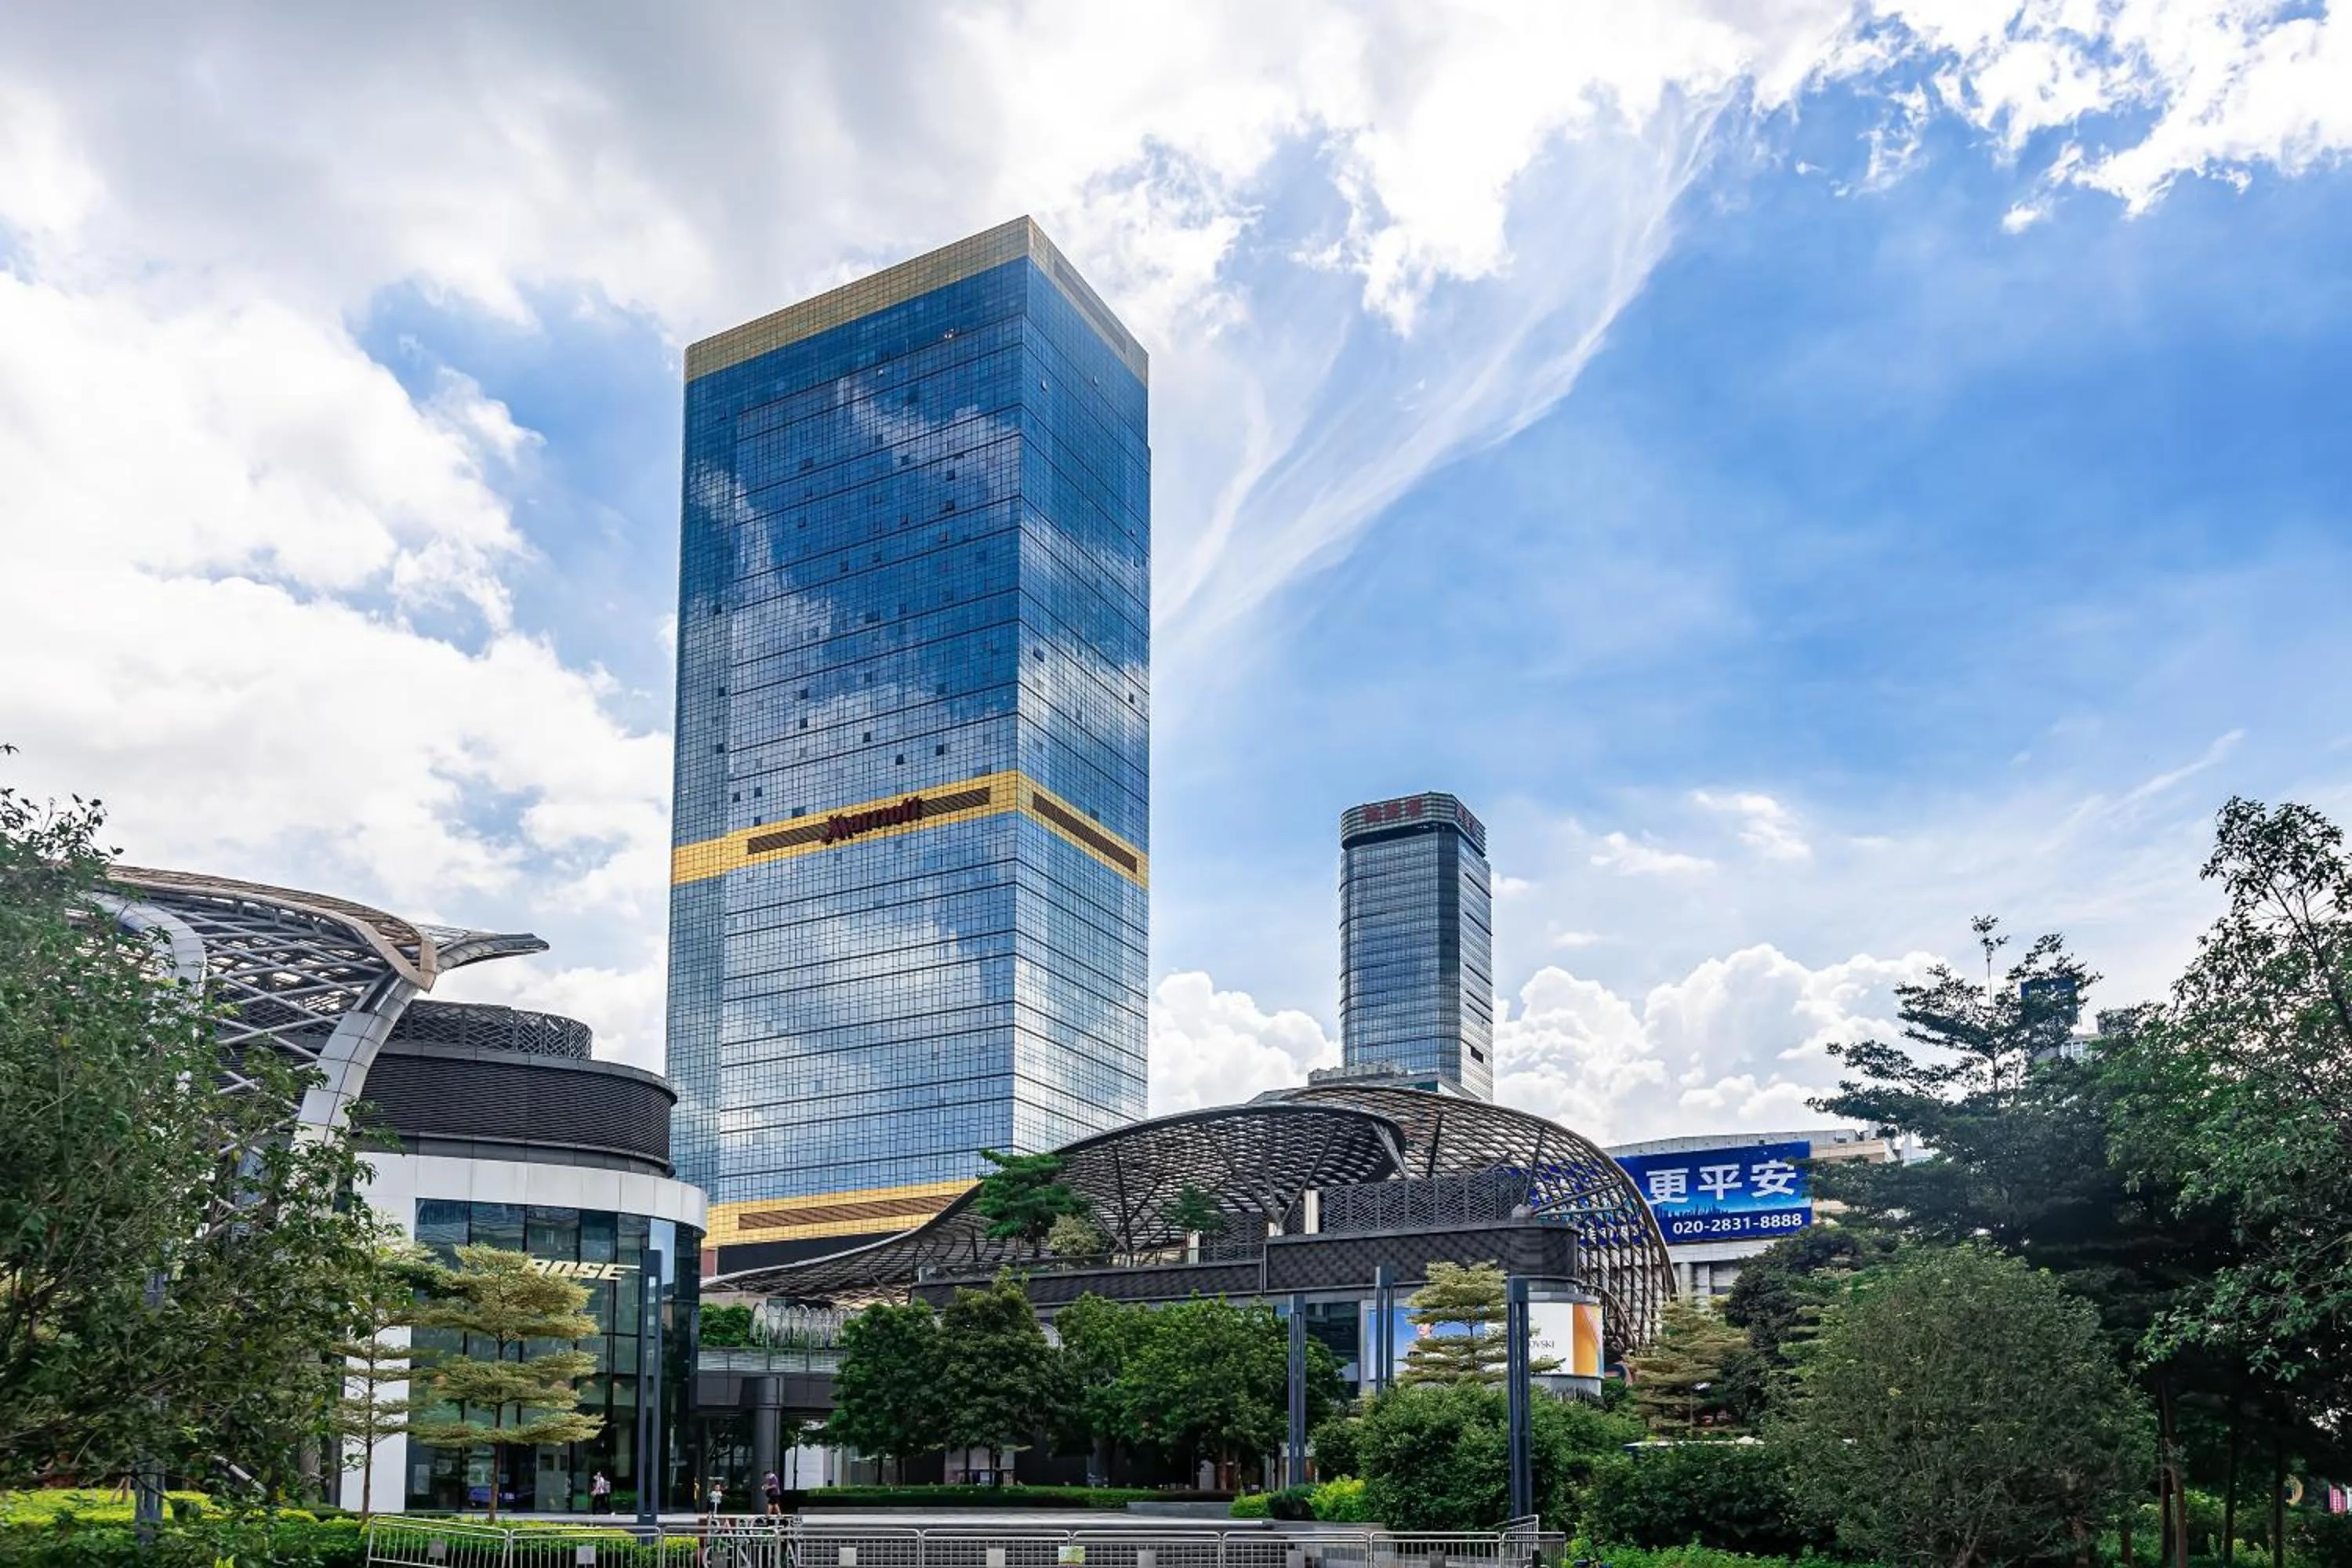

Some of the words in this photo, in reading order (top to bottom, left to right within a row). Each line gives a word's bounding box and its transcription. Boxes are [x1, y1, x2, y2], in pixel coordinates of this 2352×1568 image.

[1646, 1159, 1797, 1205] 更平安
[1672, 1213, 1802, 1235] 020-2831-8888
